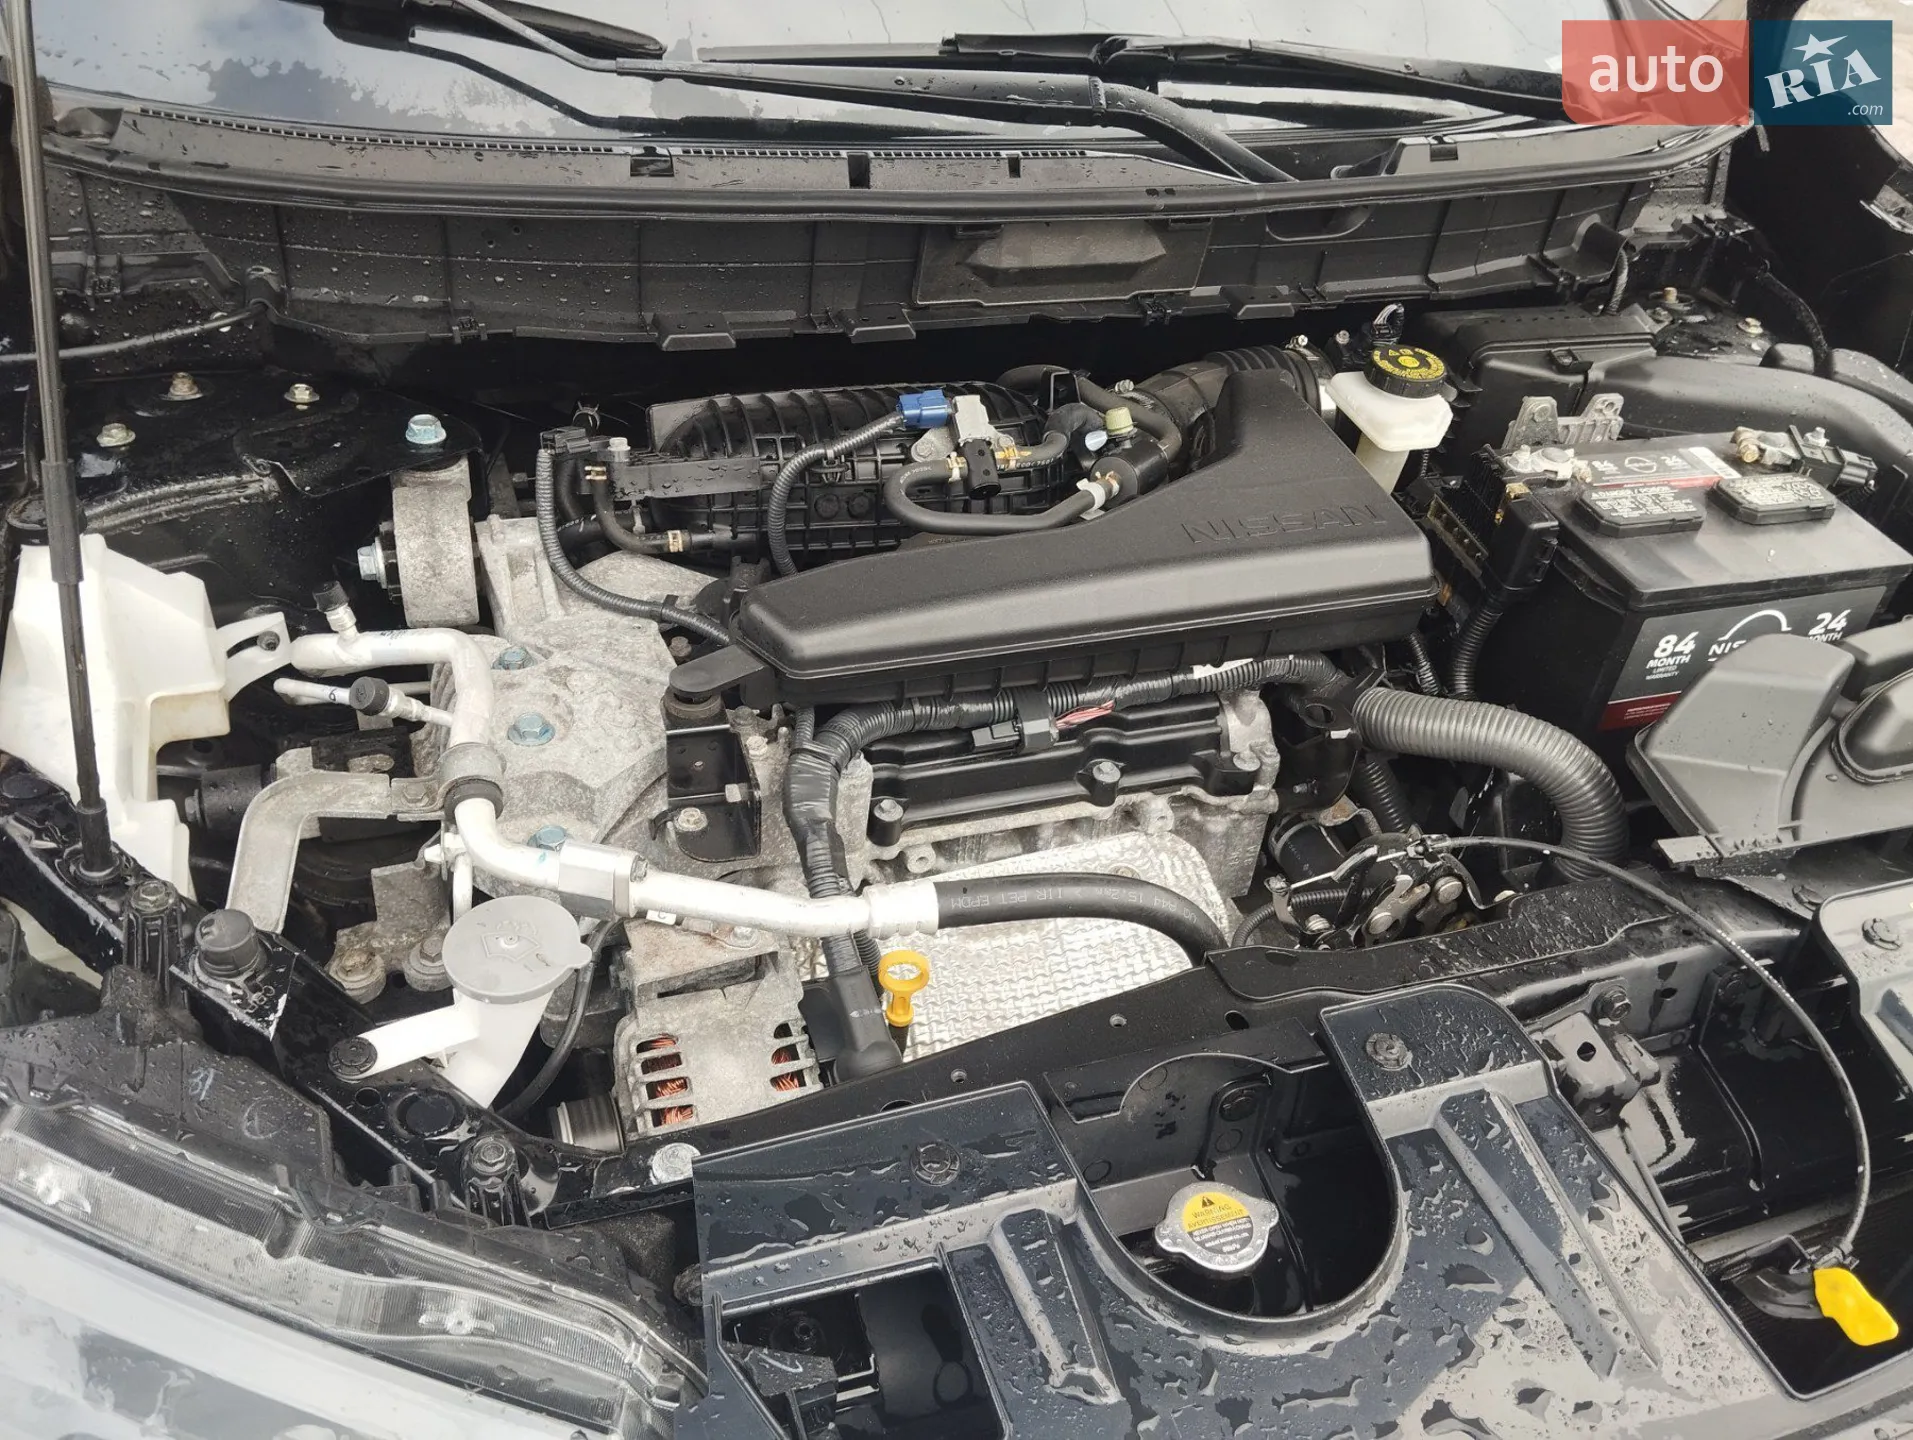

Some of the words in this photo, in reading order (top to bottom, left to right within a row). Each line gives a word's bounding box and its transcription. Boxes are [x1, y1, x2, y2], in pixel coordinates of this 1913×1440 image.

[1181, 505, 1387, 543] NISSAN
[1808, 609, 1851, 635] 24
[1809, 631, 1843, 642] ONTH
[1654, 631, 1699, 658] 84
[1646, 654, 1691, 669] MONTH
[951, 894, 990, 909] EPDM
[1000, 892, 1027, 906] PET
[1192, 1203, 1231, 1218] WARNING
